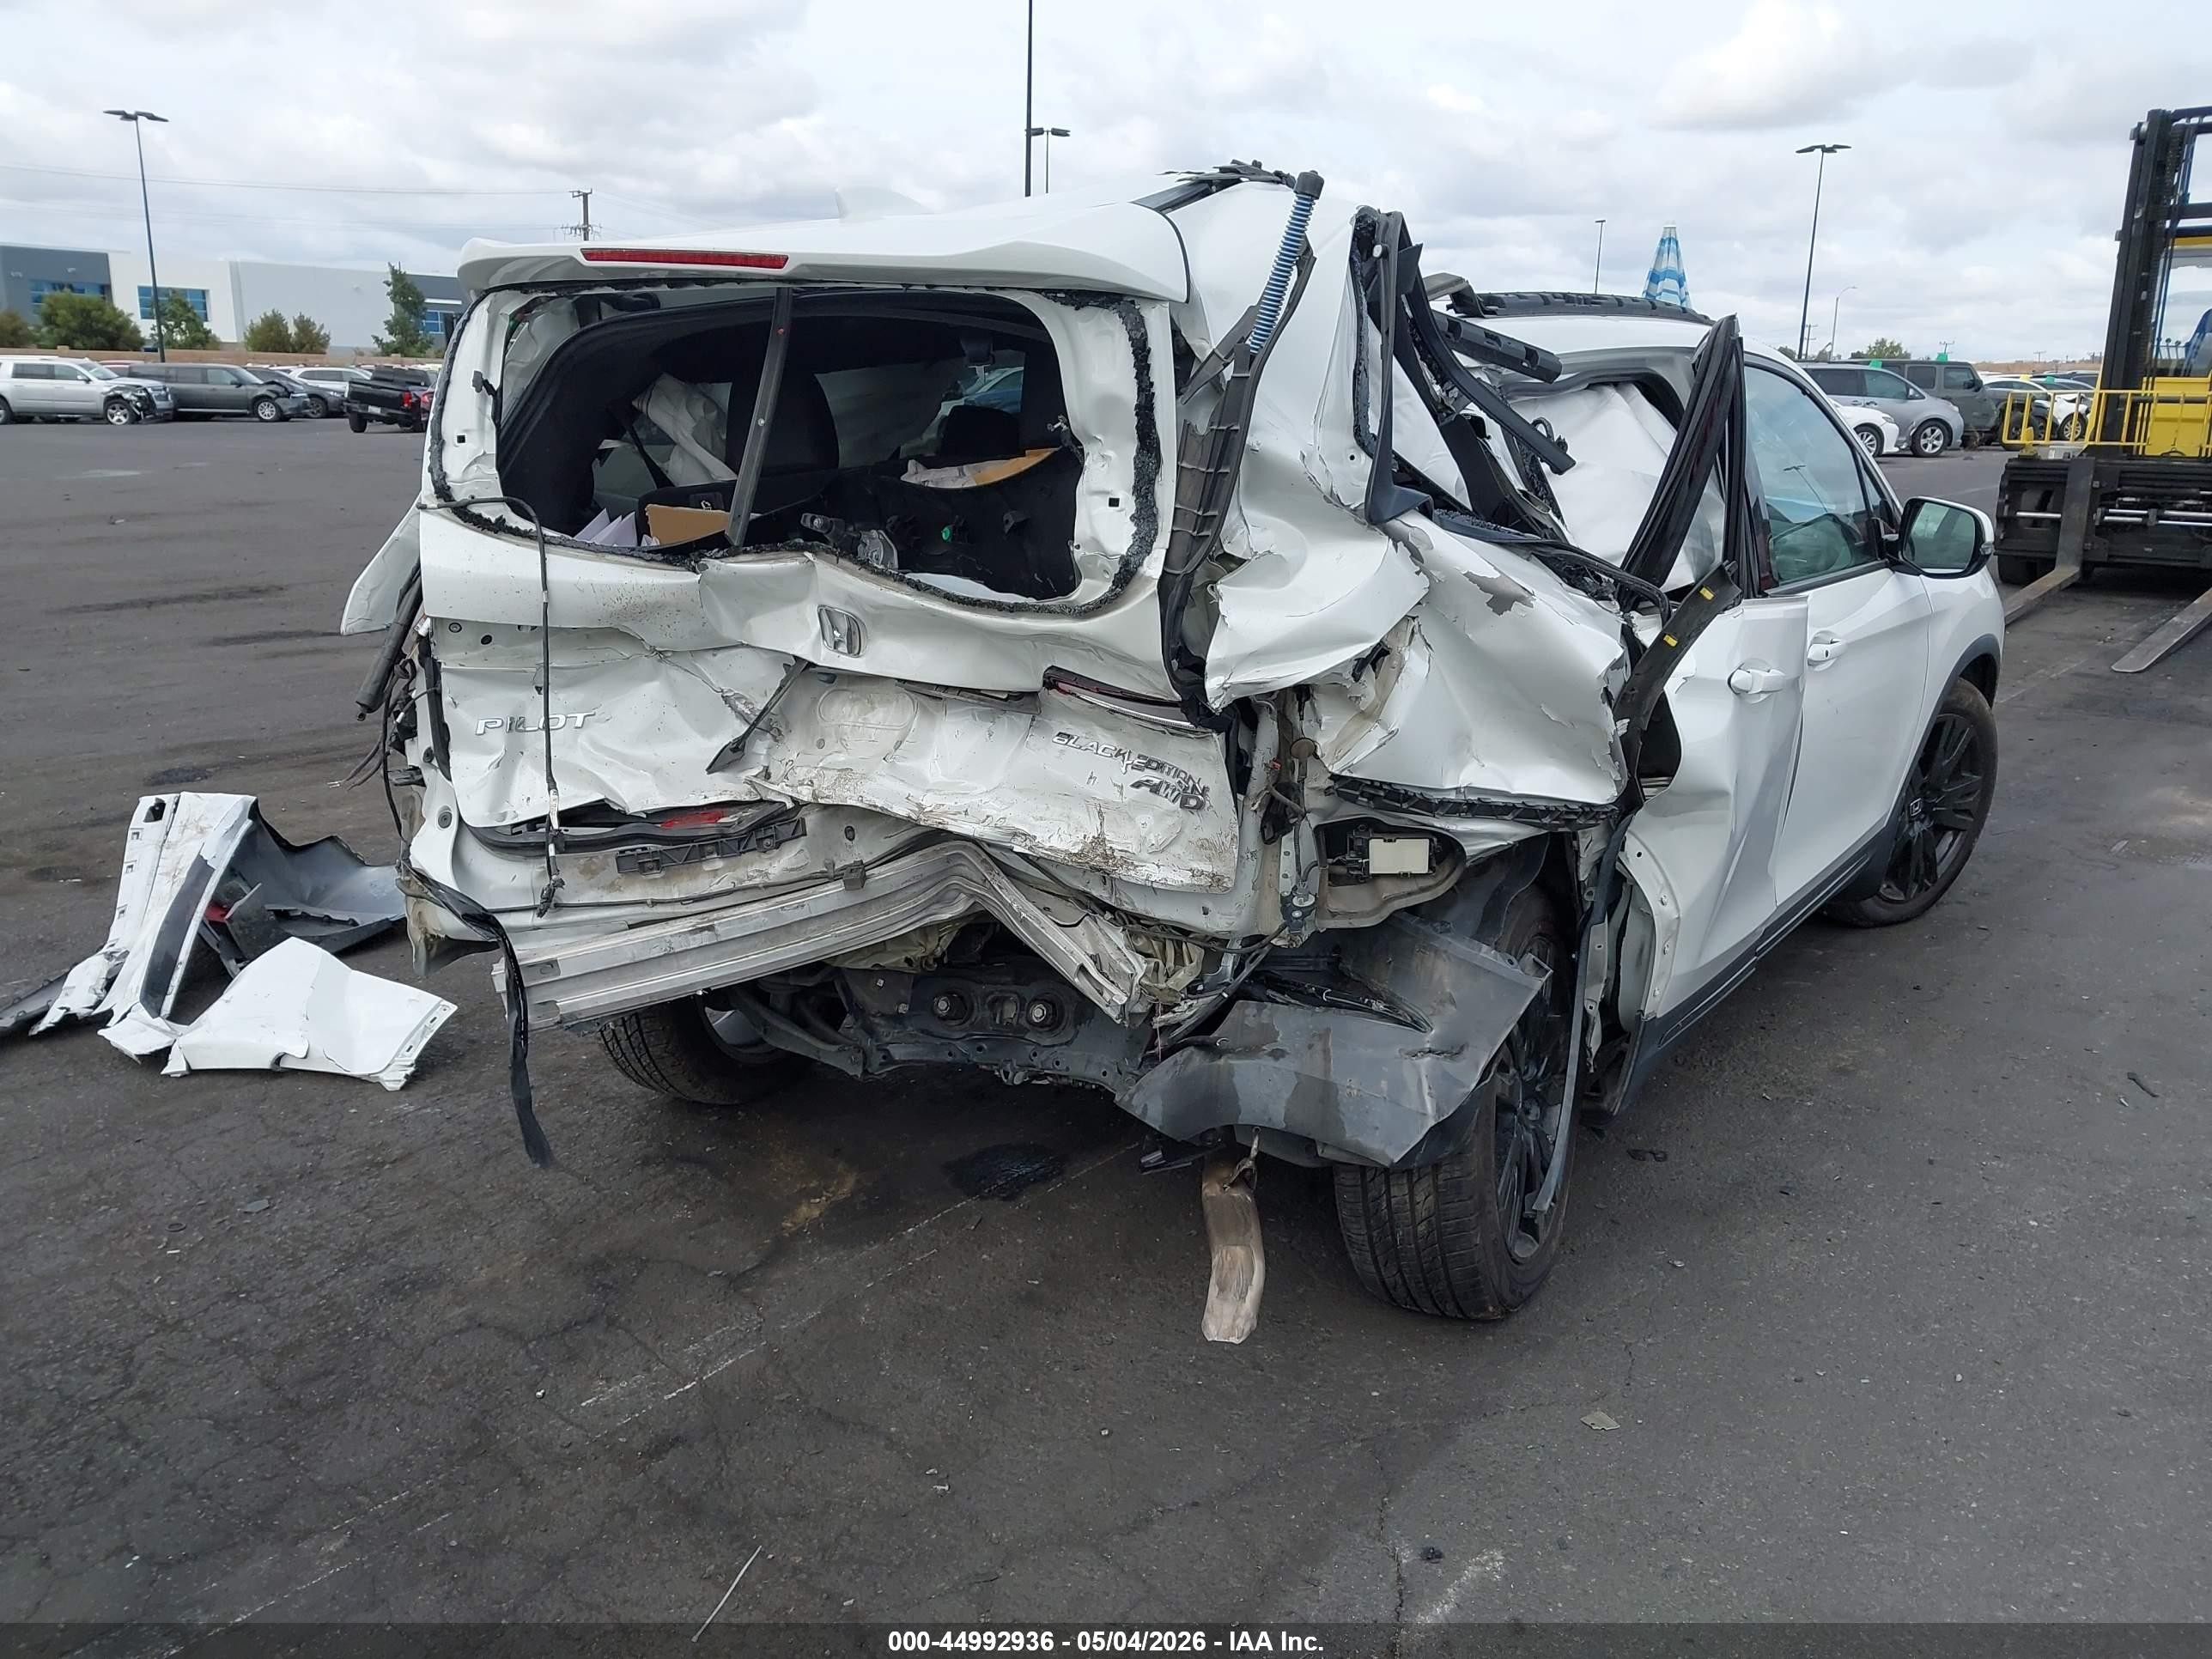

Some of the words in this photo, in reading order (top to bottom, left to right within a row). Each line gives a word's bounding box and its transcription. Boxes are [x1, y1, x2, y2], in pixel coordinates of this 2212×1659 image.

[475, 711, 596, 736] PILOT
[1052, 731, 1133, 775] BLACK
[1129, 775, 1206, 811] AWD
